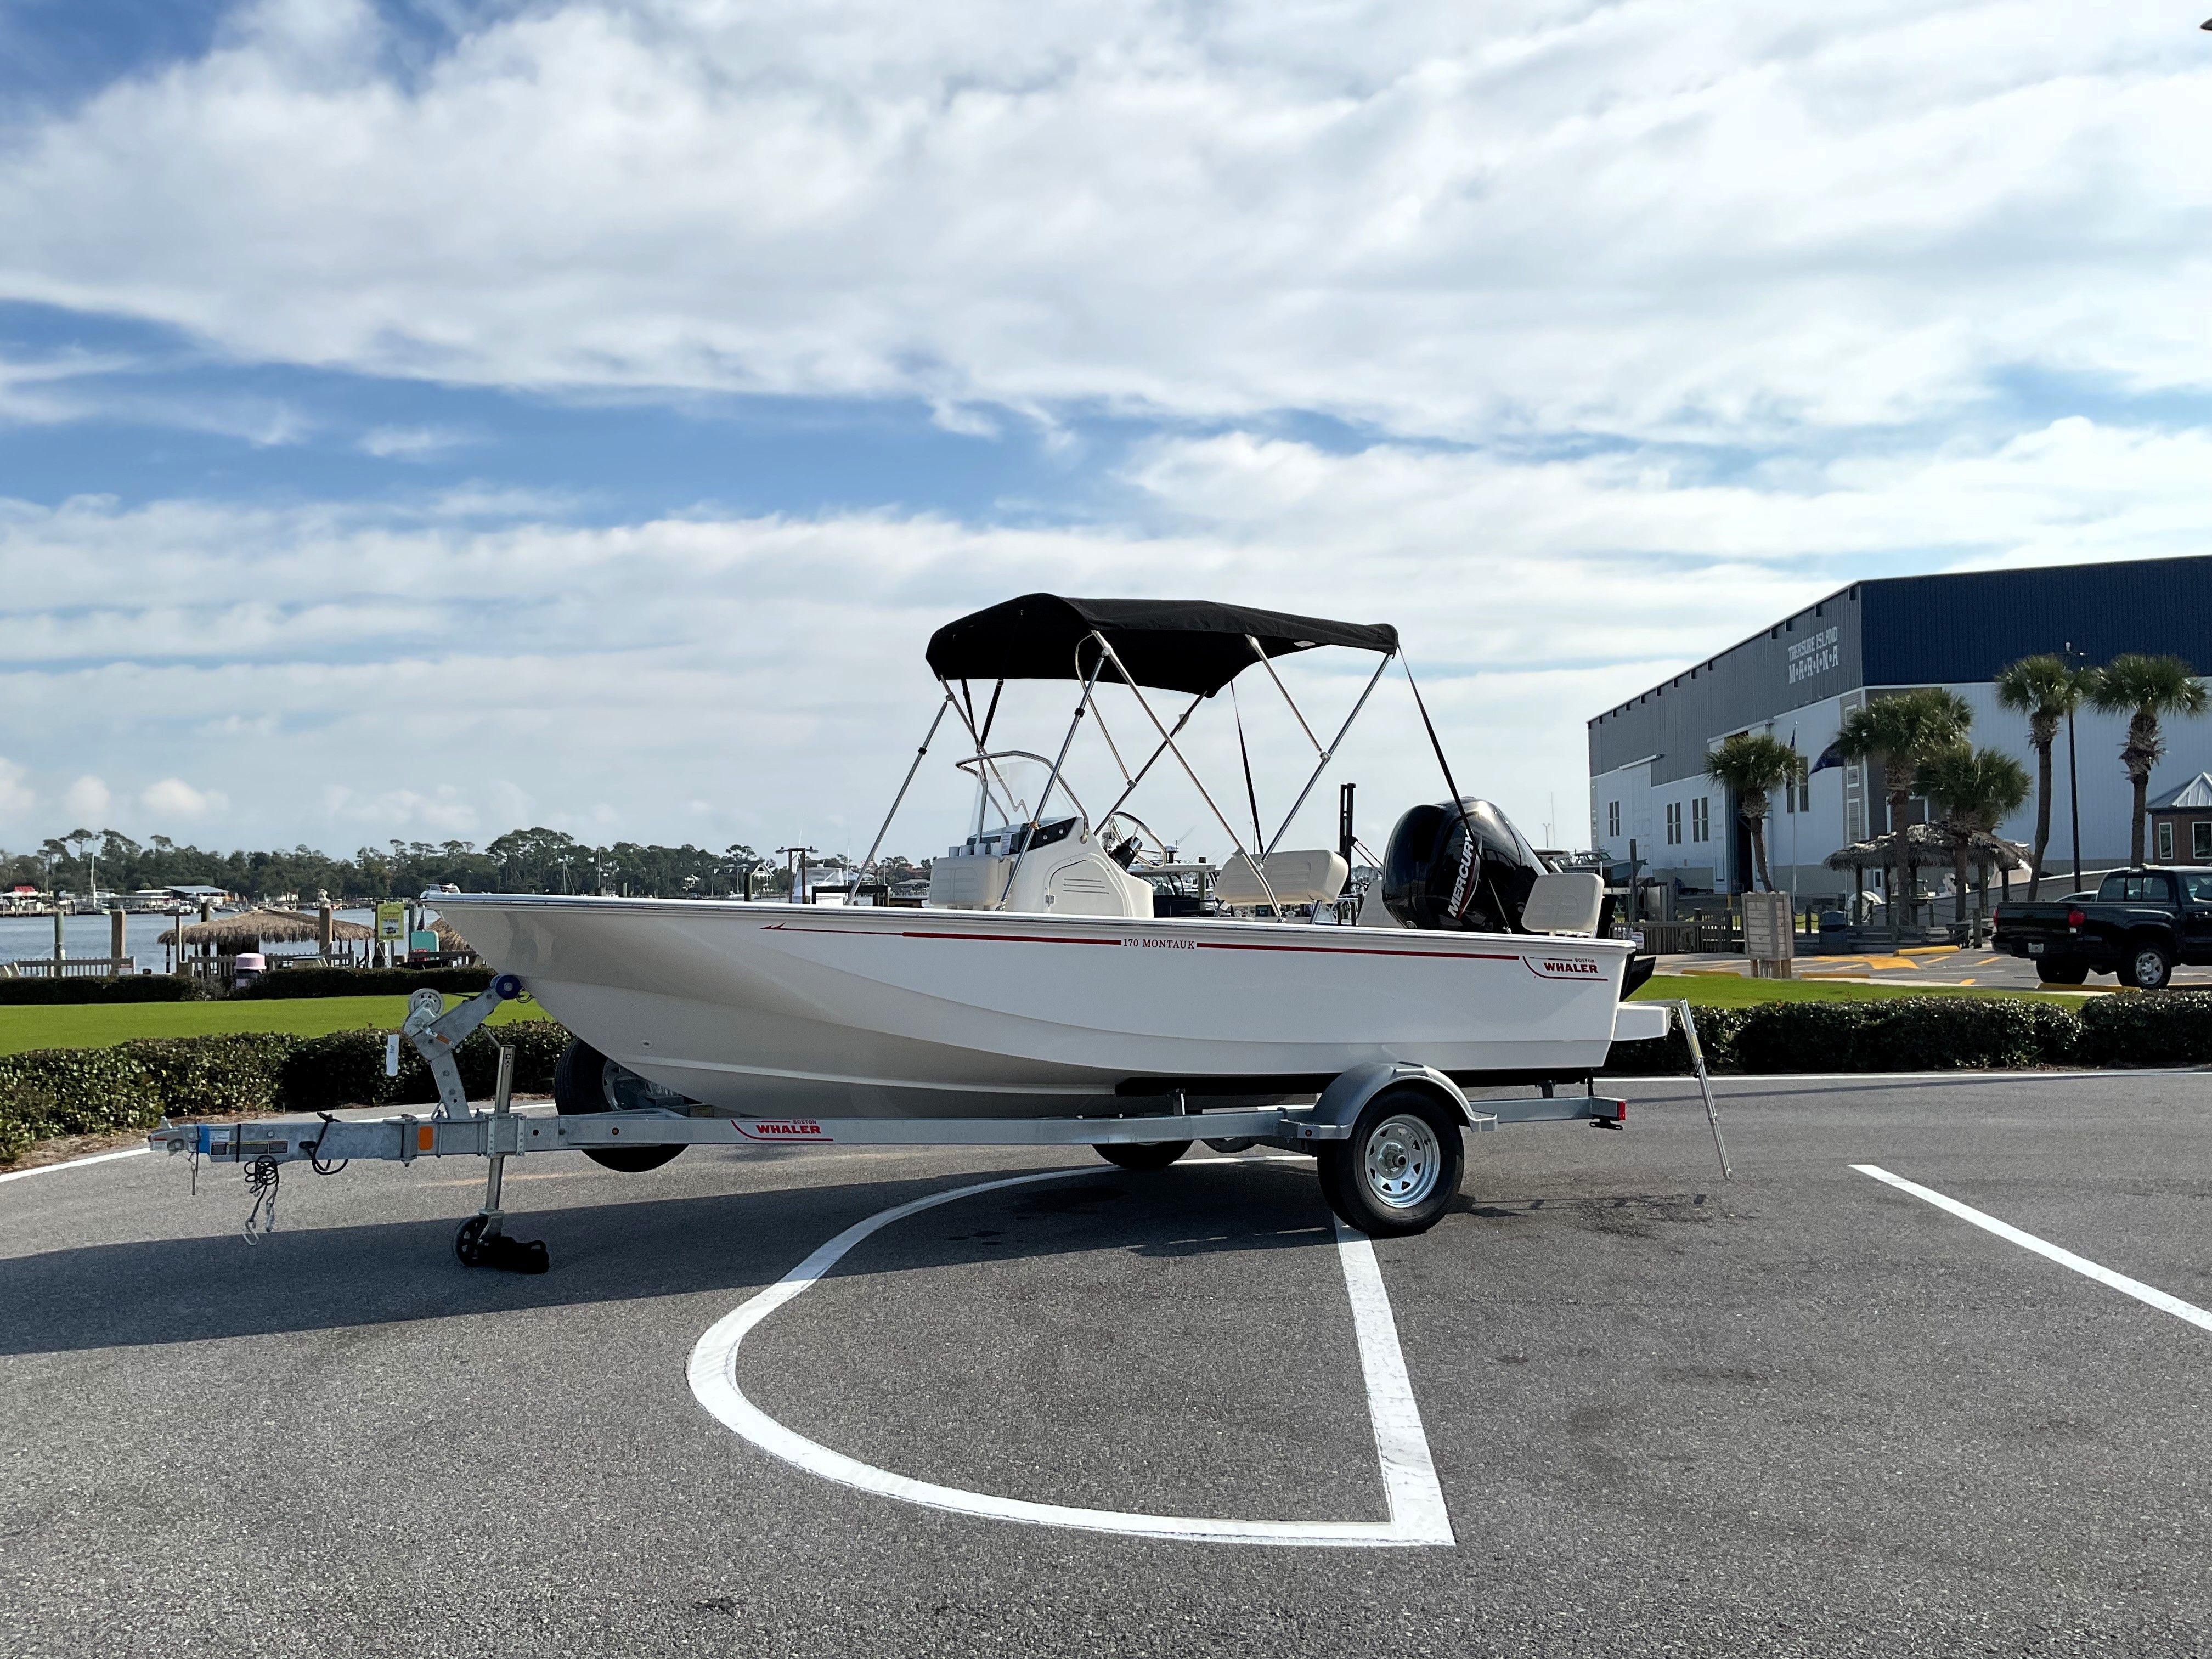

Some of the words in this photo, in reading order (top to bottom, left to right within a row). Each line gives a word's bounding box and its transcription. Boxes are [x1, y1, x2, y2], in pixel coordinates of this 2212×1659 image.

[1816, 626, 1837, 650] ISLAND
[1448, 829, 1474, 917] MERCURY
[1124, 939, 1138, 947] 170
[1142, 939, 1195, 949] MONTAUK
[1543, 962, 1598, 973] WHALER
[756, 1125, 822, 1135] WHALER
